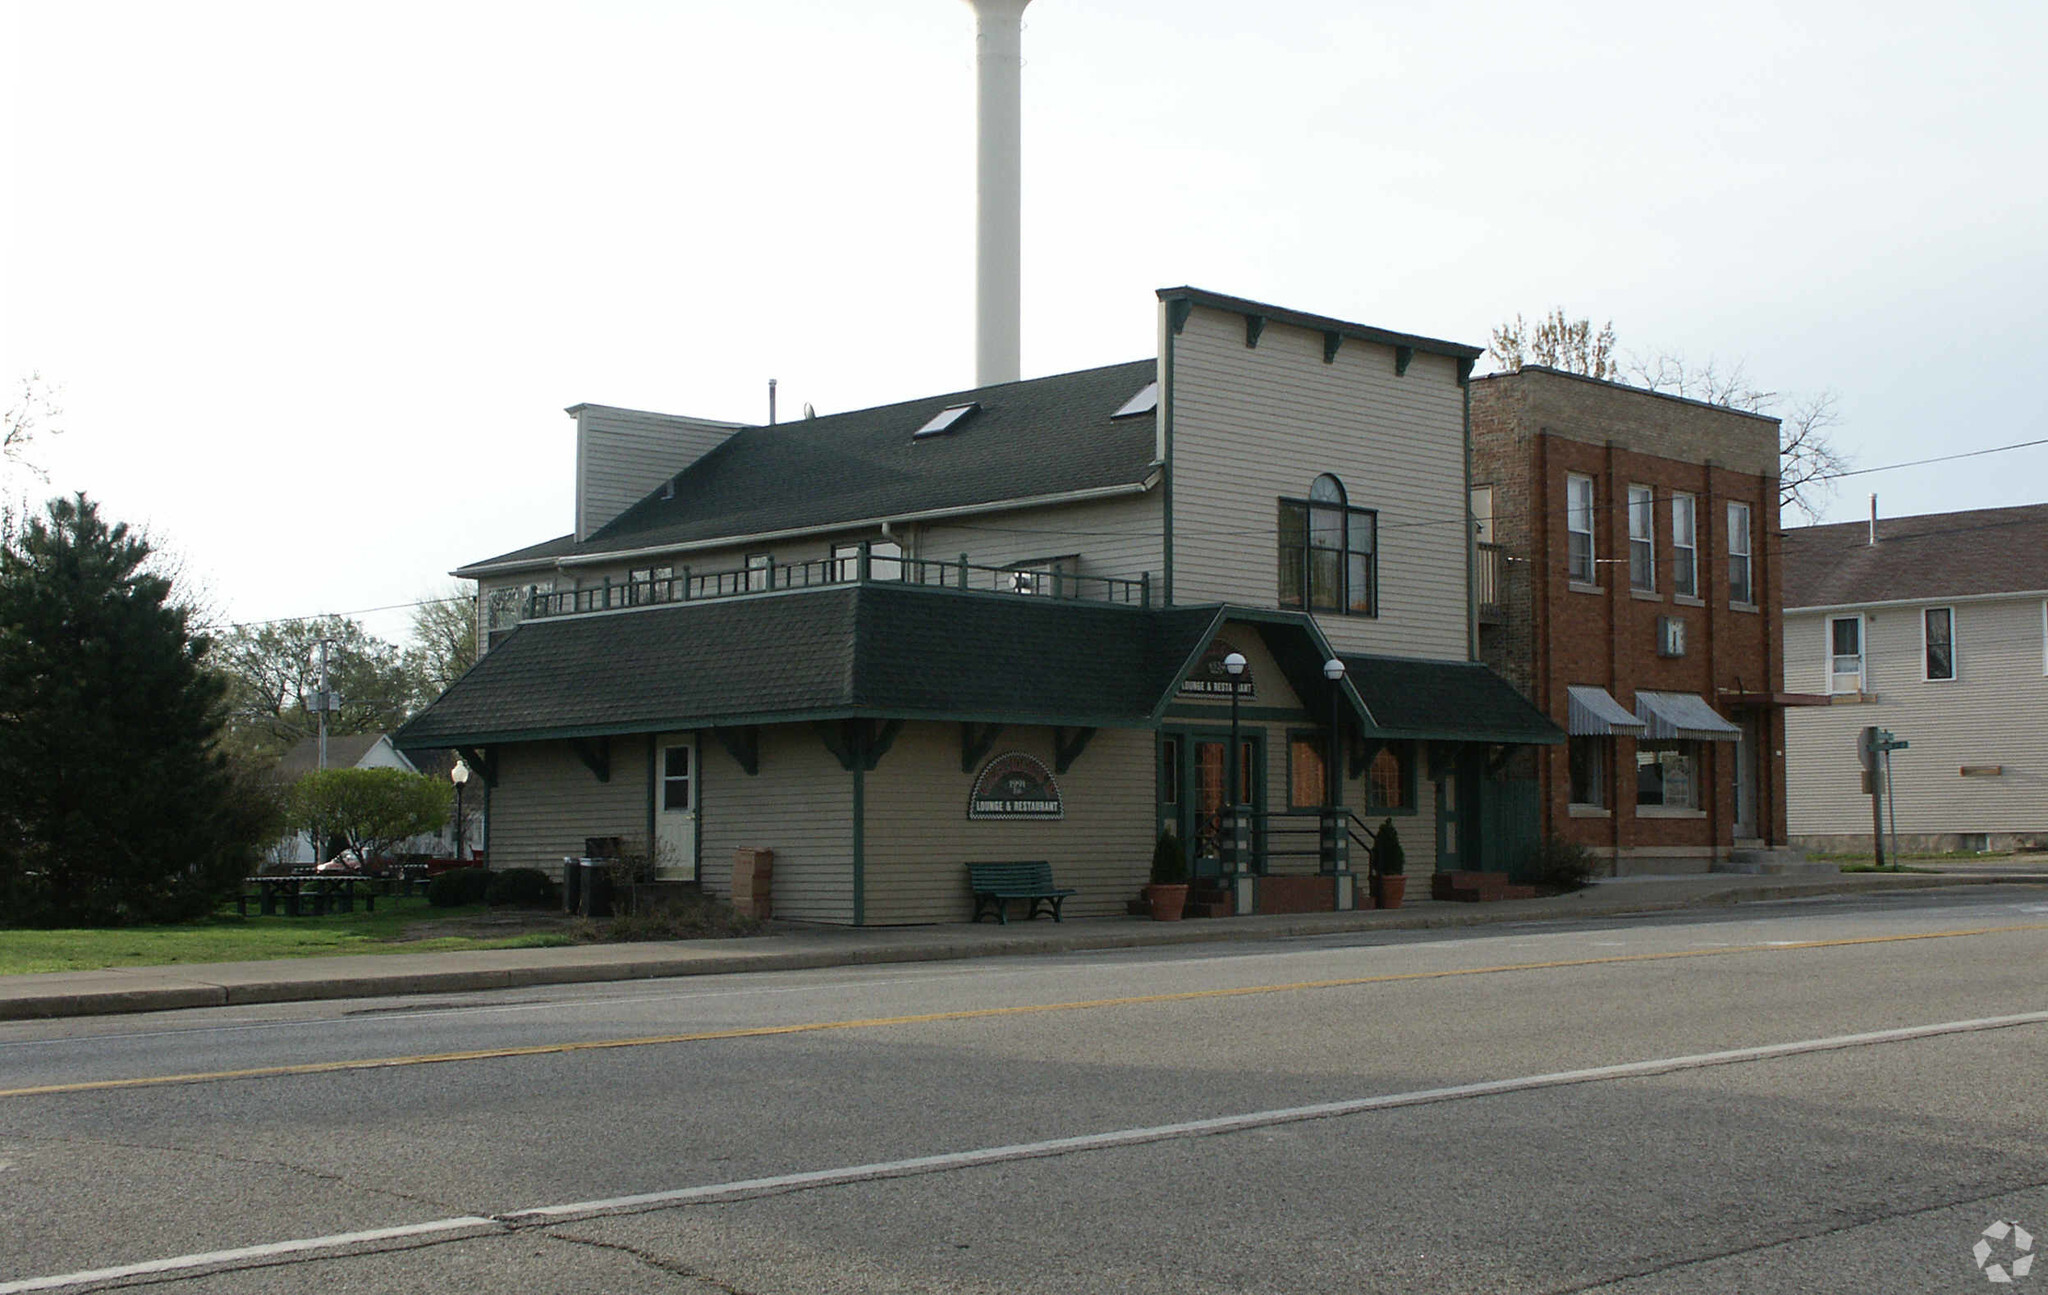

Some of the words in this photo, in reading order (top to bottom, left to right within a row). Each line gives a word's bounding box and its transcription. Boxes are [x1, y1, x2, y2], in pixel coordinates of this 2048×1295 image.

[1181, 680, 1205, 691] LOUNGE
[976, 800, 1004, 811] LOUNGE
[1005, 800, 1012, 811] &
[1013, 800, 1058, 811] RESTAURANT
